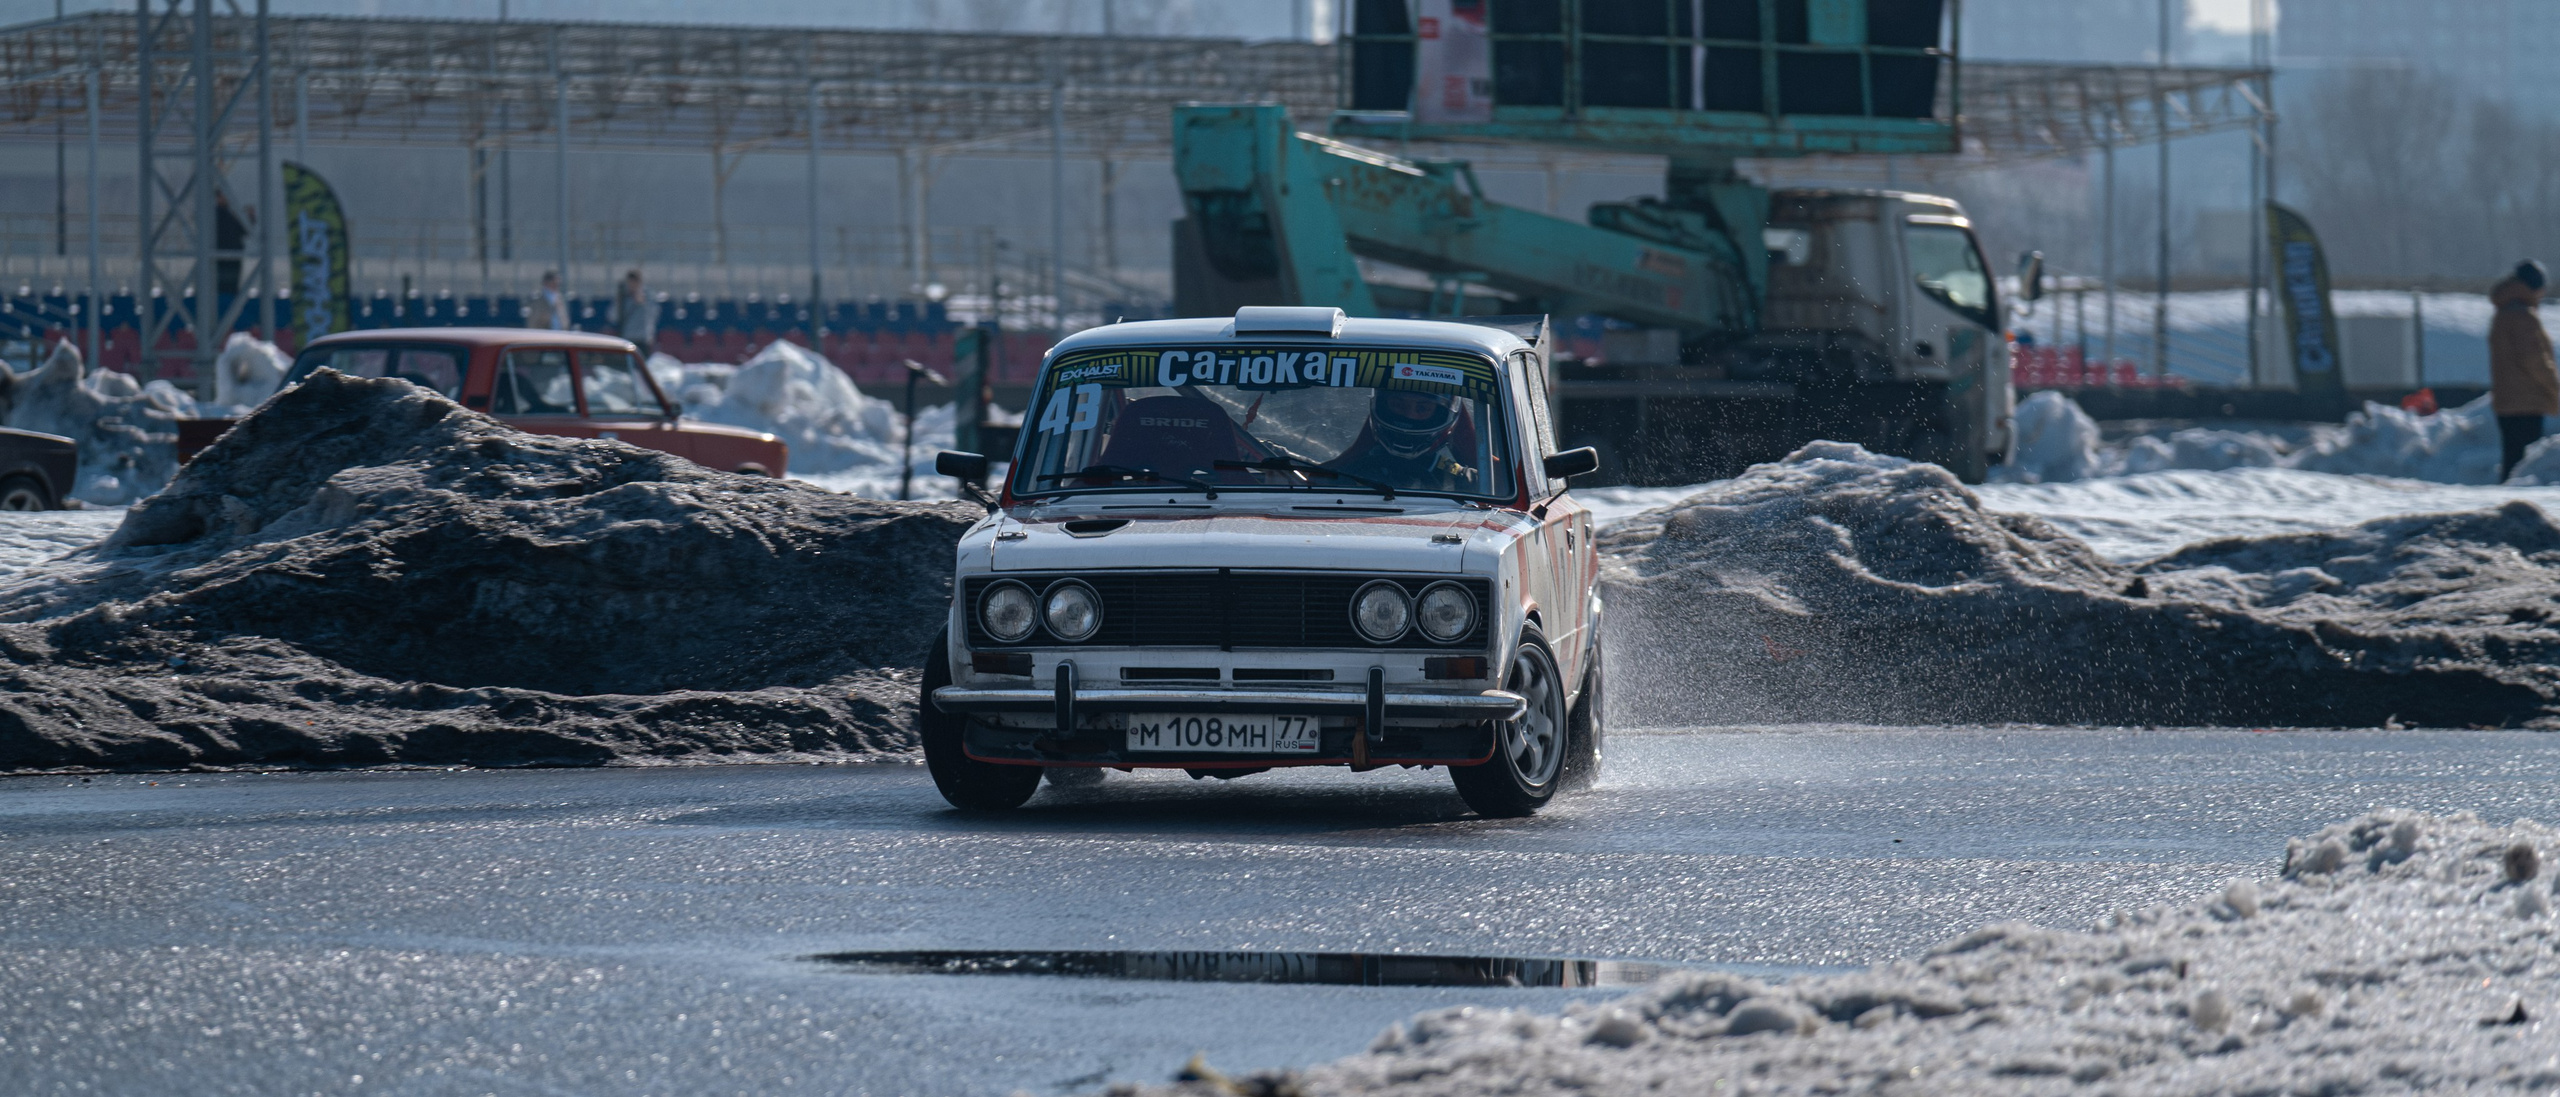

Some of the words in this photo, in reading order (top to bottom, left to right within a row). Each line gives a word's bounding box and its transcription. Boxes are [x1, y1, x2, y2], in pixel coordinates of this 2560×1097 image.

[298, 209, 332, 343] XHAUST
[1059, 364, 1122, 382] EXHAUST
[1415, 370, 1457, 381] TAKAYAMA
[1038, 383, 1102, 435] 43
[1140, 417, 1209, 429] BRIDE
[1278, 716, 1308, 740] 77
[1275, 740, 1298, 749] RUS
